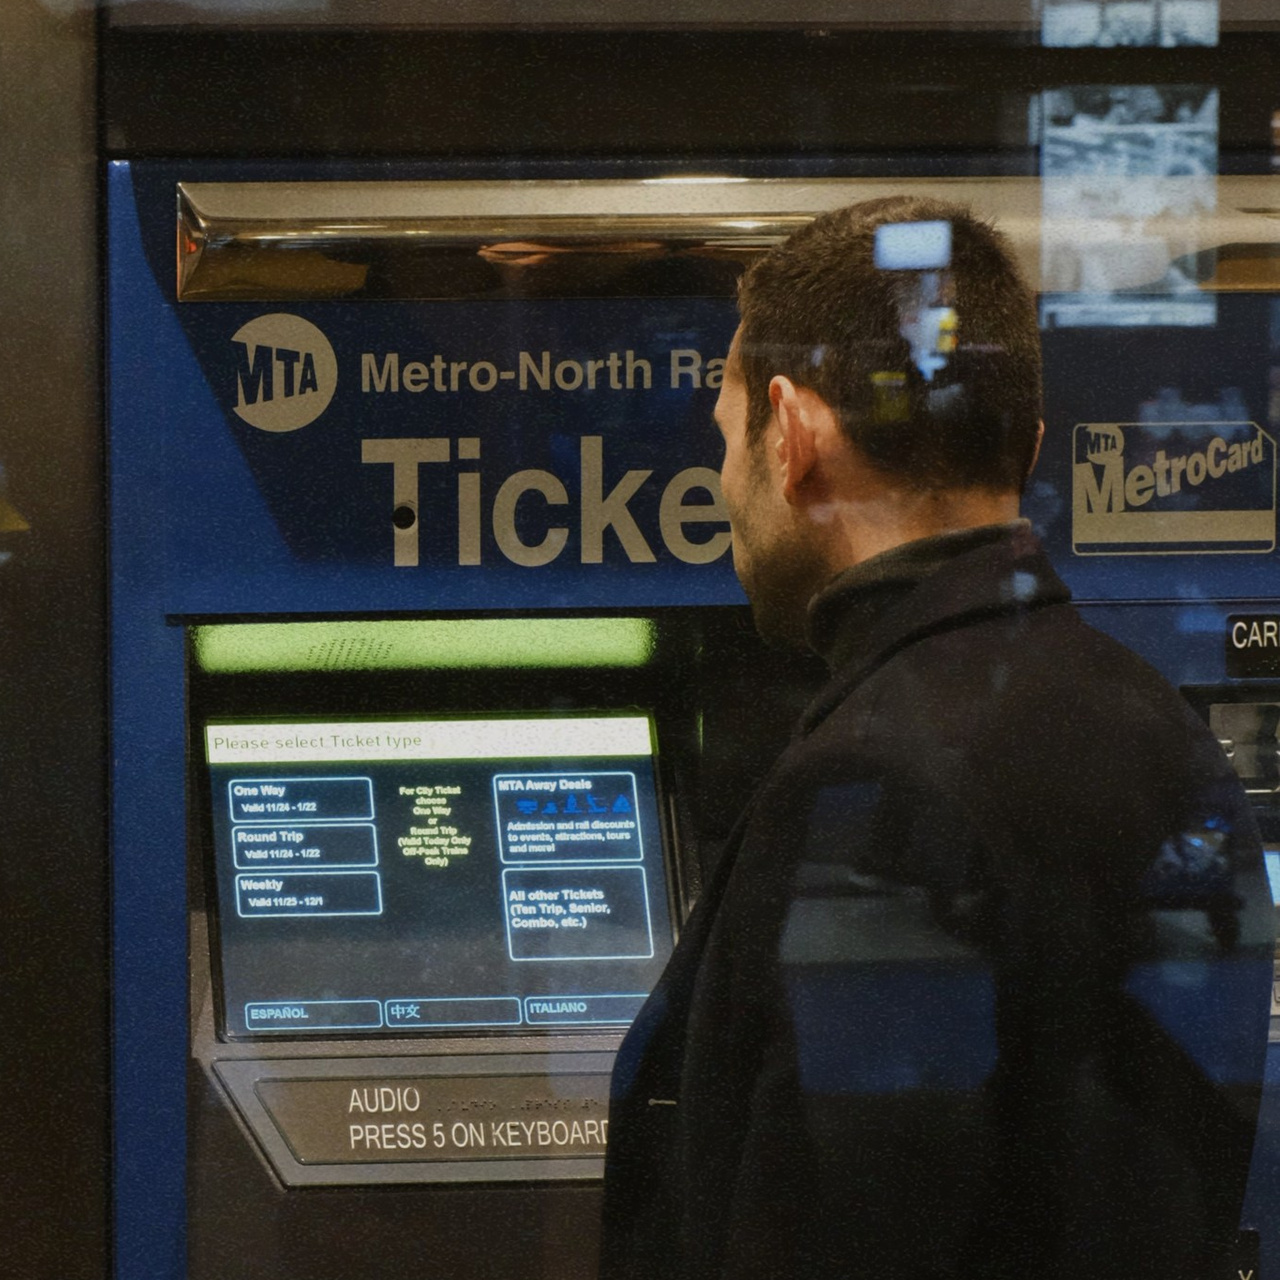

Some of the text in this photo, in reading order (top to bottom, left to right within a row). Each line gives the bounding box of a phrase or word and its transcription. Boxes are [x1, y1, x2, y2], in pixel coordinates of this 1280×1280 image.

[236, 342, 319, 410] MTA
[360, 350, 652, 394] Metro-North
[1086, 432, 1117, 456] MTA
[1073, 431, 1264, 514] MetroCard
[360, 435, 734, 568] Ticke
[1232, 622, 1280, 648] CAR
[214, 735, 422, 750] Please select Ticket type
[234, 785, 285, 797] One Way
[498, 779, 592, 792] MTA Away Deals
[241, 804, 264, 812] Valid
[297, 802, 316, 811] 1/22
[413, 806, 451, 816] One Way
[440, 826, 457, 835] Trip
[591, 820, 635, 829] discounts
[238, 831, 303, 843] Round Trip
[508, 833, 518, 841] to
[607, 831, 630, 839] tours
[245, 850, 268, 858] Valid
[301, 849, 320, 857] 1/22
[509, 844, 527, 852] and
[240, 879, 283, 891] Weekly
[510, 889, 604, 901] All other Tickets
[248, 898, 272, 906] Valid
[569, 903, 611, 914] Senior,
[251, 1006, 309, 1020] ESPAÑOL
[530, 1002, 587, 1014] ITALIANO
[349, 1088, 419, 1112] AUDIO
[350, 1124, 426, 1149] PRESS
[433, 1123, 445, 1147] 5
[452, 1123, 485, 1147] ON
